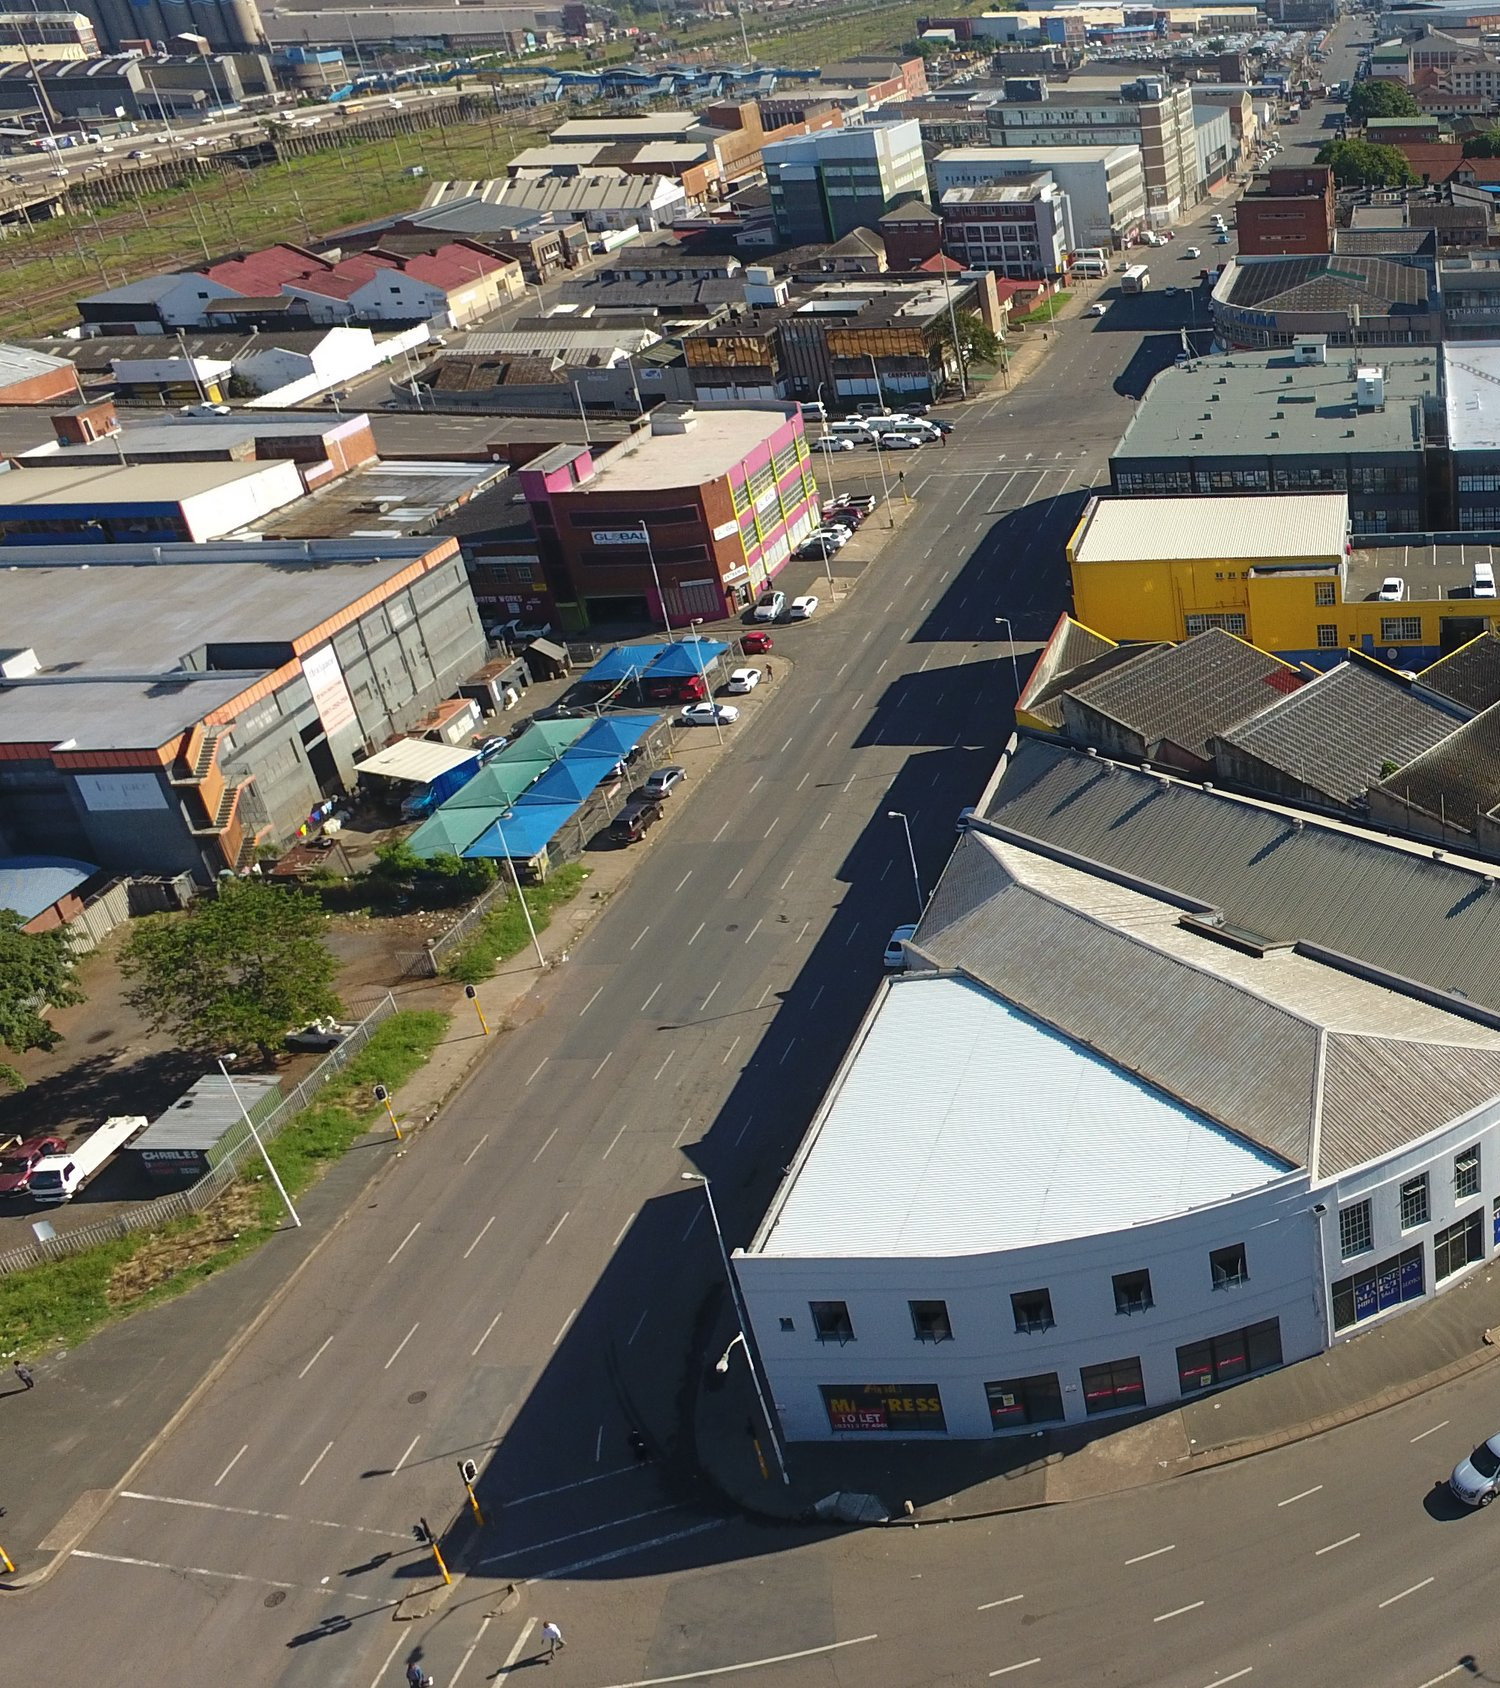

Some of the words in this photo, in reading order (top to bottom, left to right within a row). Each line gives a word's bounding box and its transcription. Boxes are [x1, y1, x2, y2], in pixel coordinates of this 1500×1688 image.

[142, 1150, 199, 1160] CHARLES
[829, 1398, 940, 1412] MARESS
[841, 1414, 856, 1423] TO
[859, 1413, 880, 1423] LET
